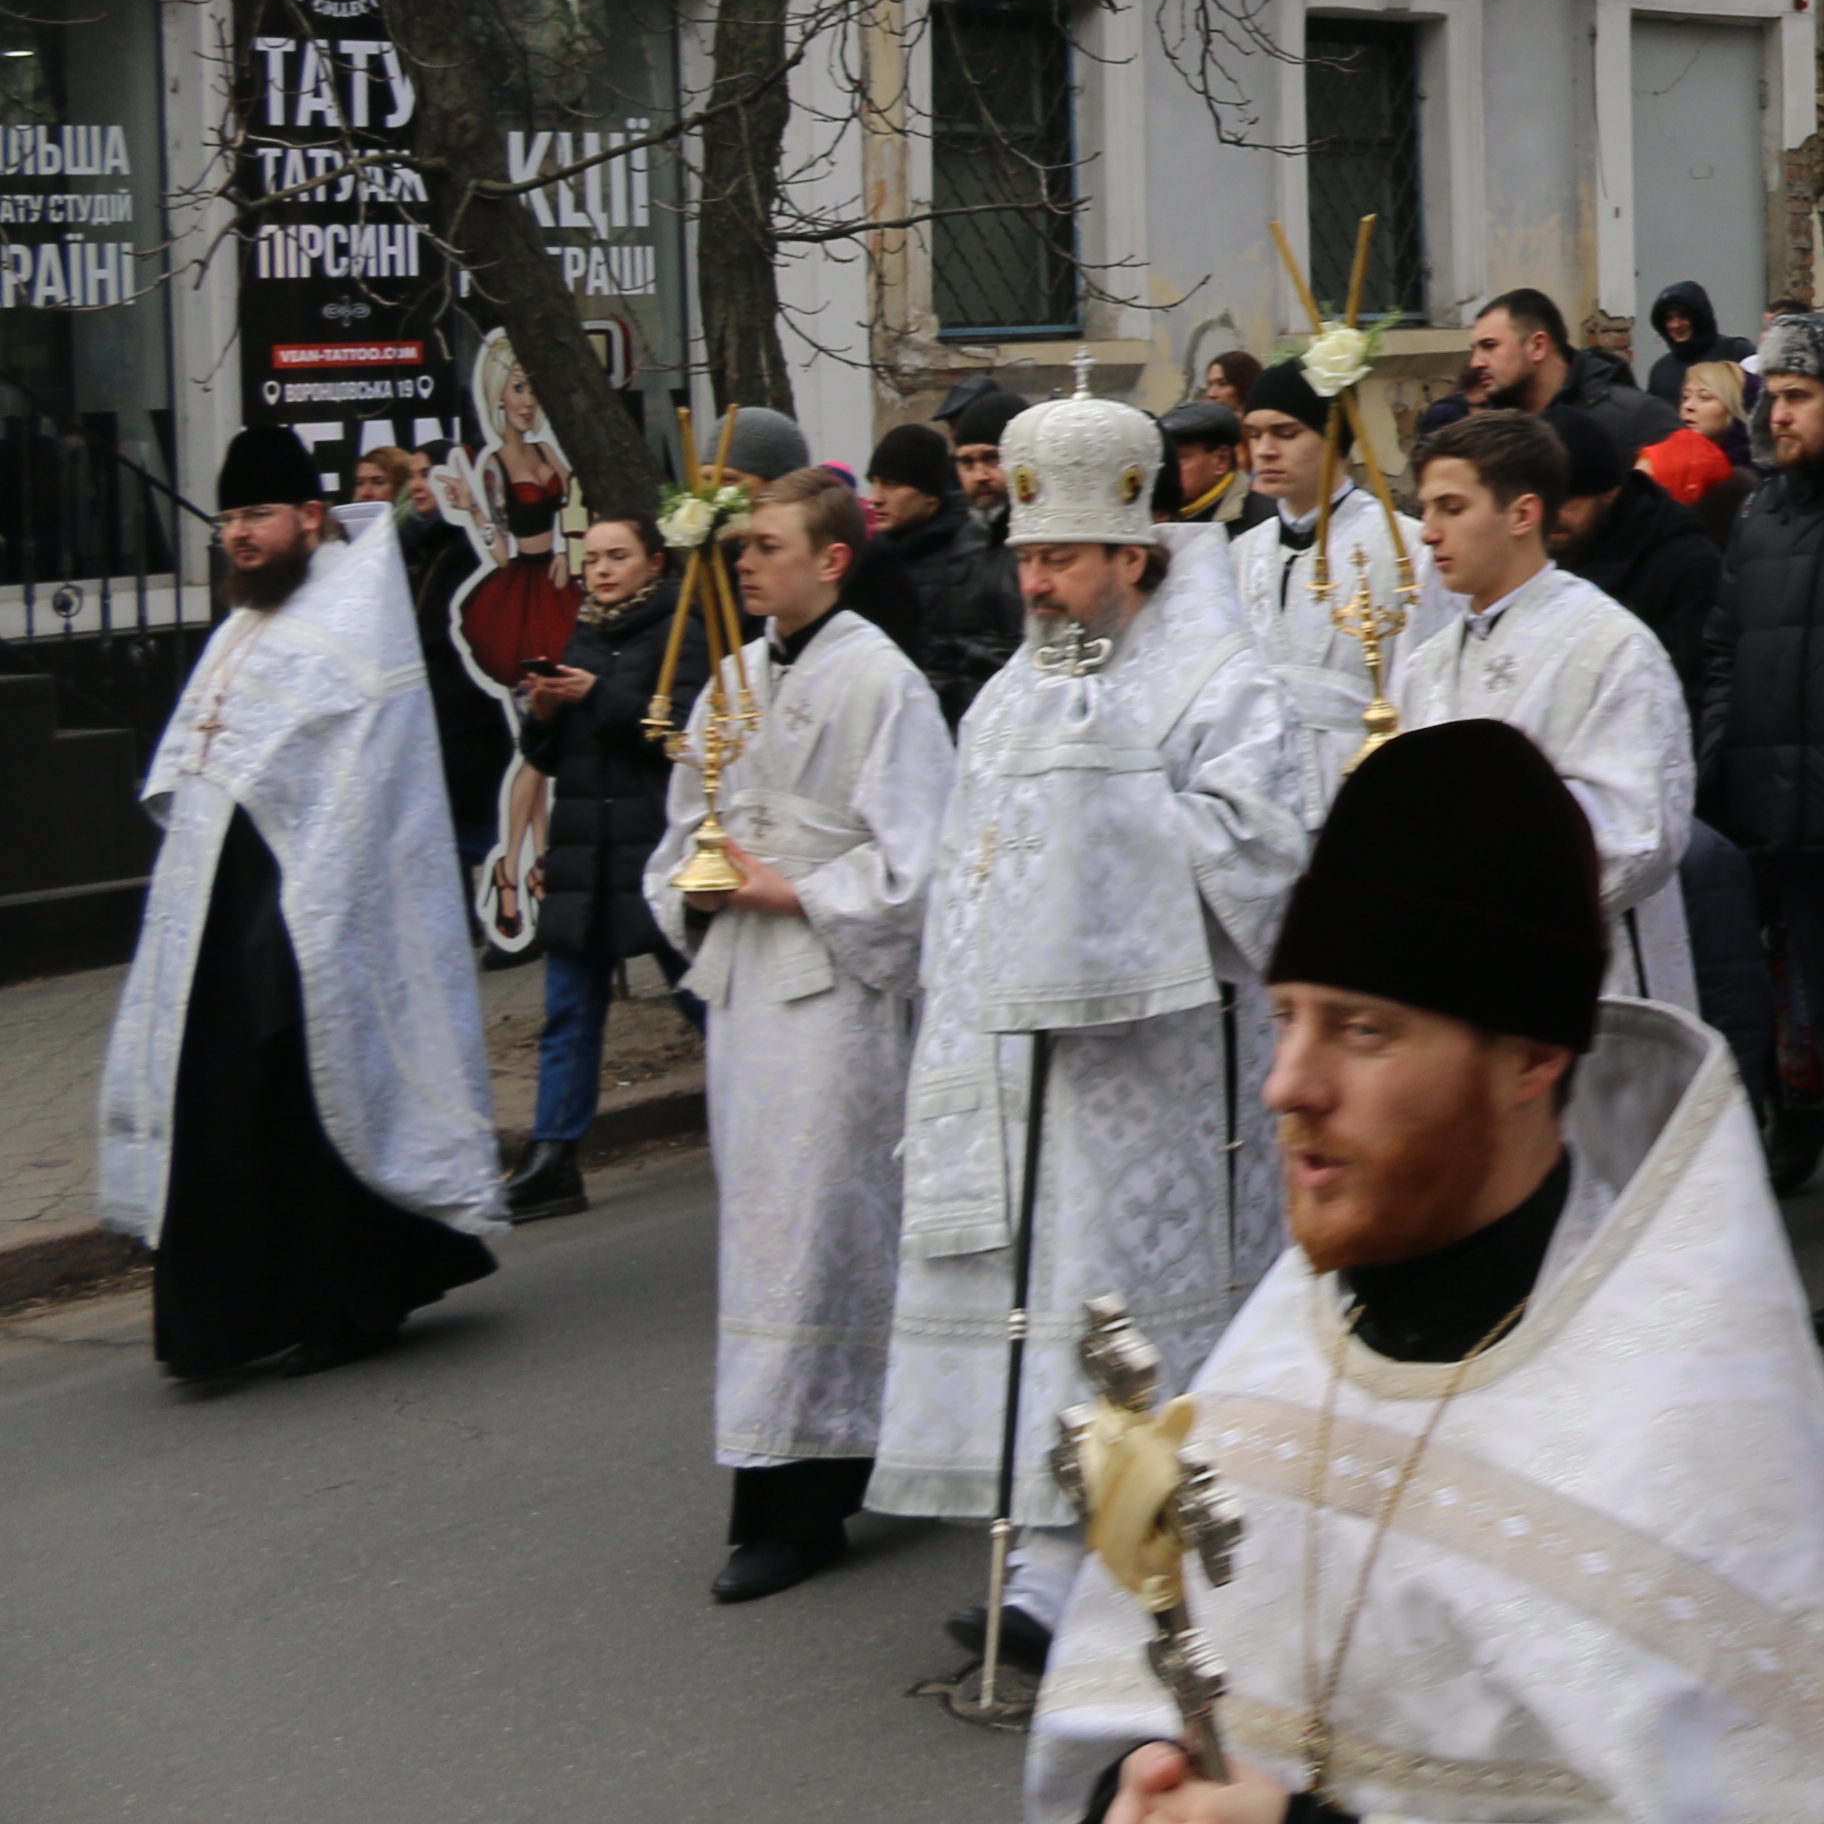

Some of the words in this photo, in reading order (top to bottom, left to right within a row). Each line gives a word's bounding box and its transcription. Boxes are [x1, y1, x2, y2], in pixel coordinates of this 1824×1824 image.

[254, 37, 415, 128] ТАТУ
[507, 117, 650, 240] КЦІЇ
[50, 188, 134, 226] СТУДІЙ
[258, 224, 430, 279] ПІРСИНГ
[397, 379, 415, 398] 19
